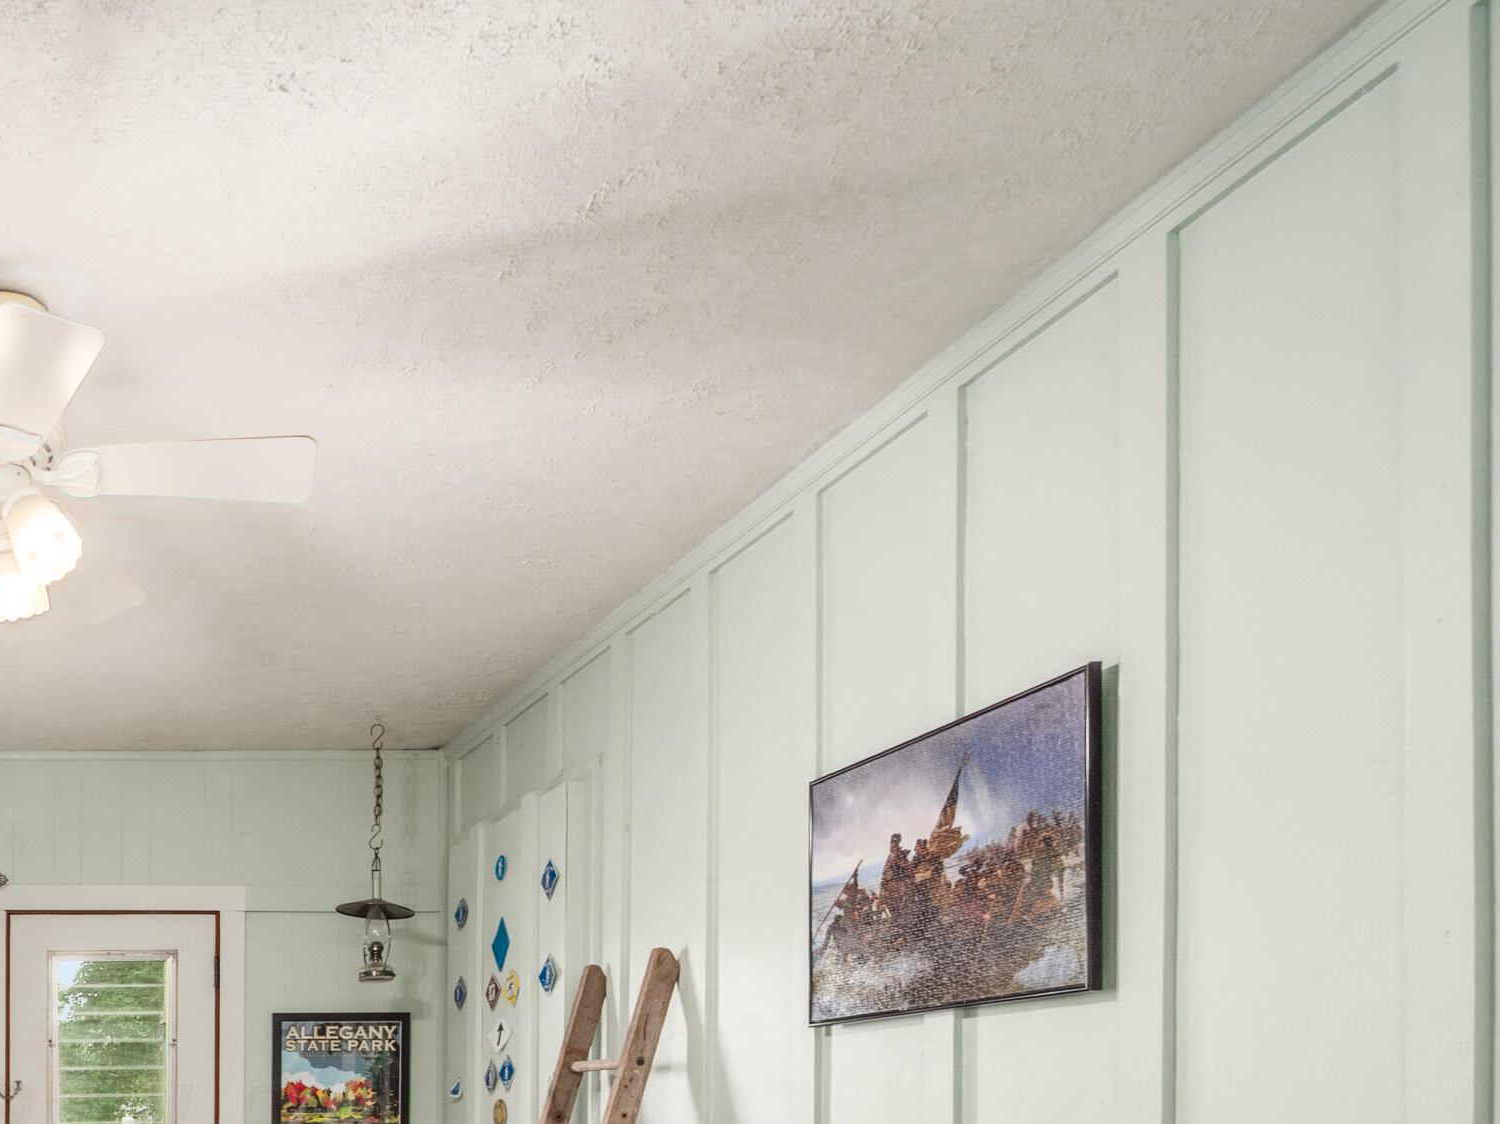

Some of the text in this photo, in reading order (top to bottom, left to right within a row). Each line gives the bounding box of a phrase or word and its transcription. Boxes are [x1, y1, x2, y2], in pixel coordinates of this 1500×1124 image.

[285, 1025, 398, 1040] ALLEGANY
[285, 1039, 397, 1052] STATE PARK
